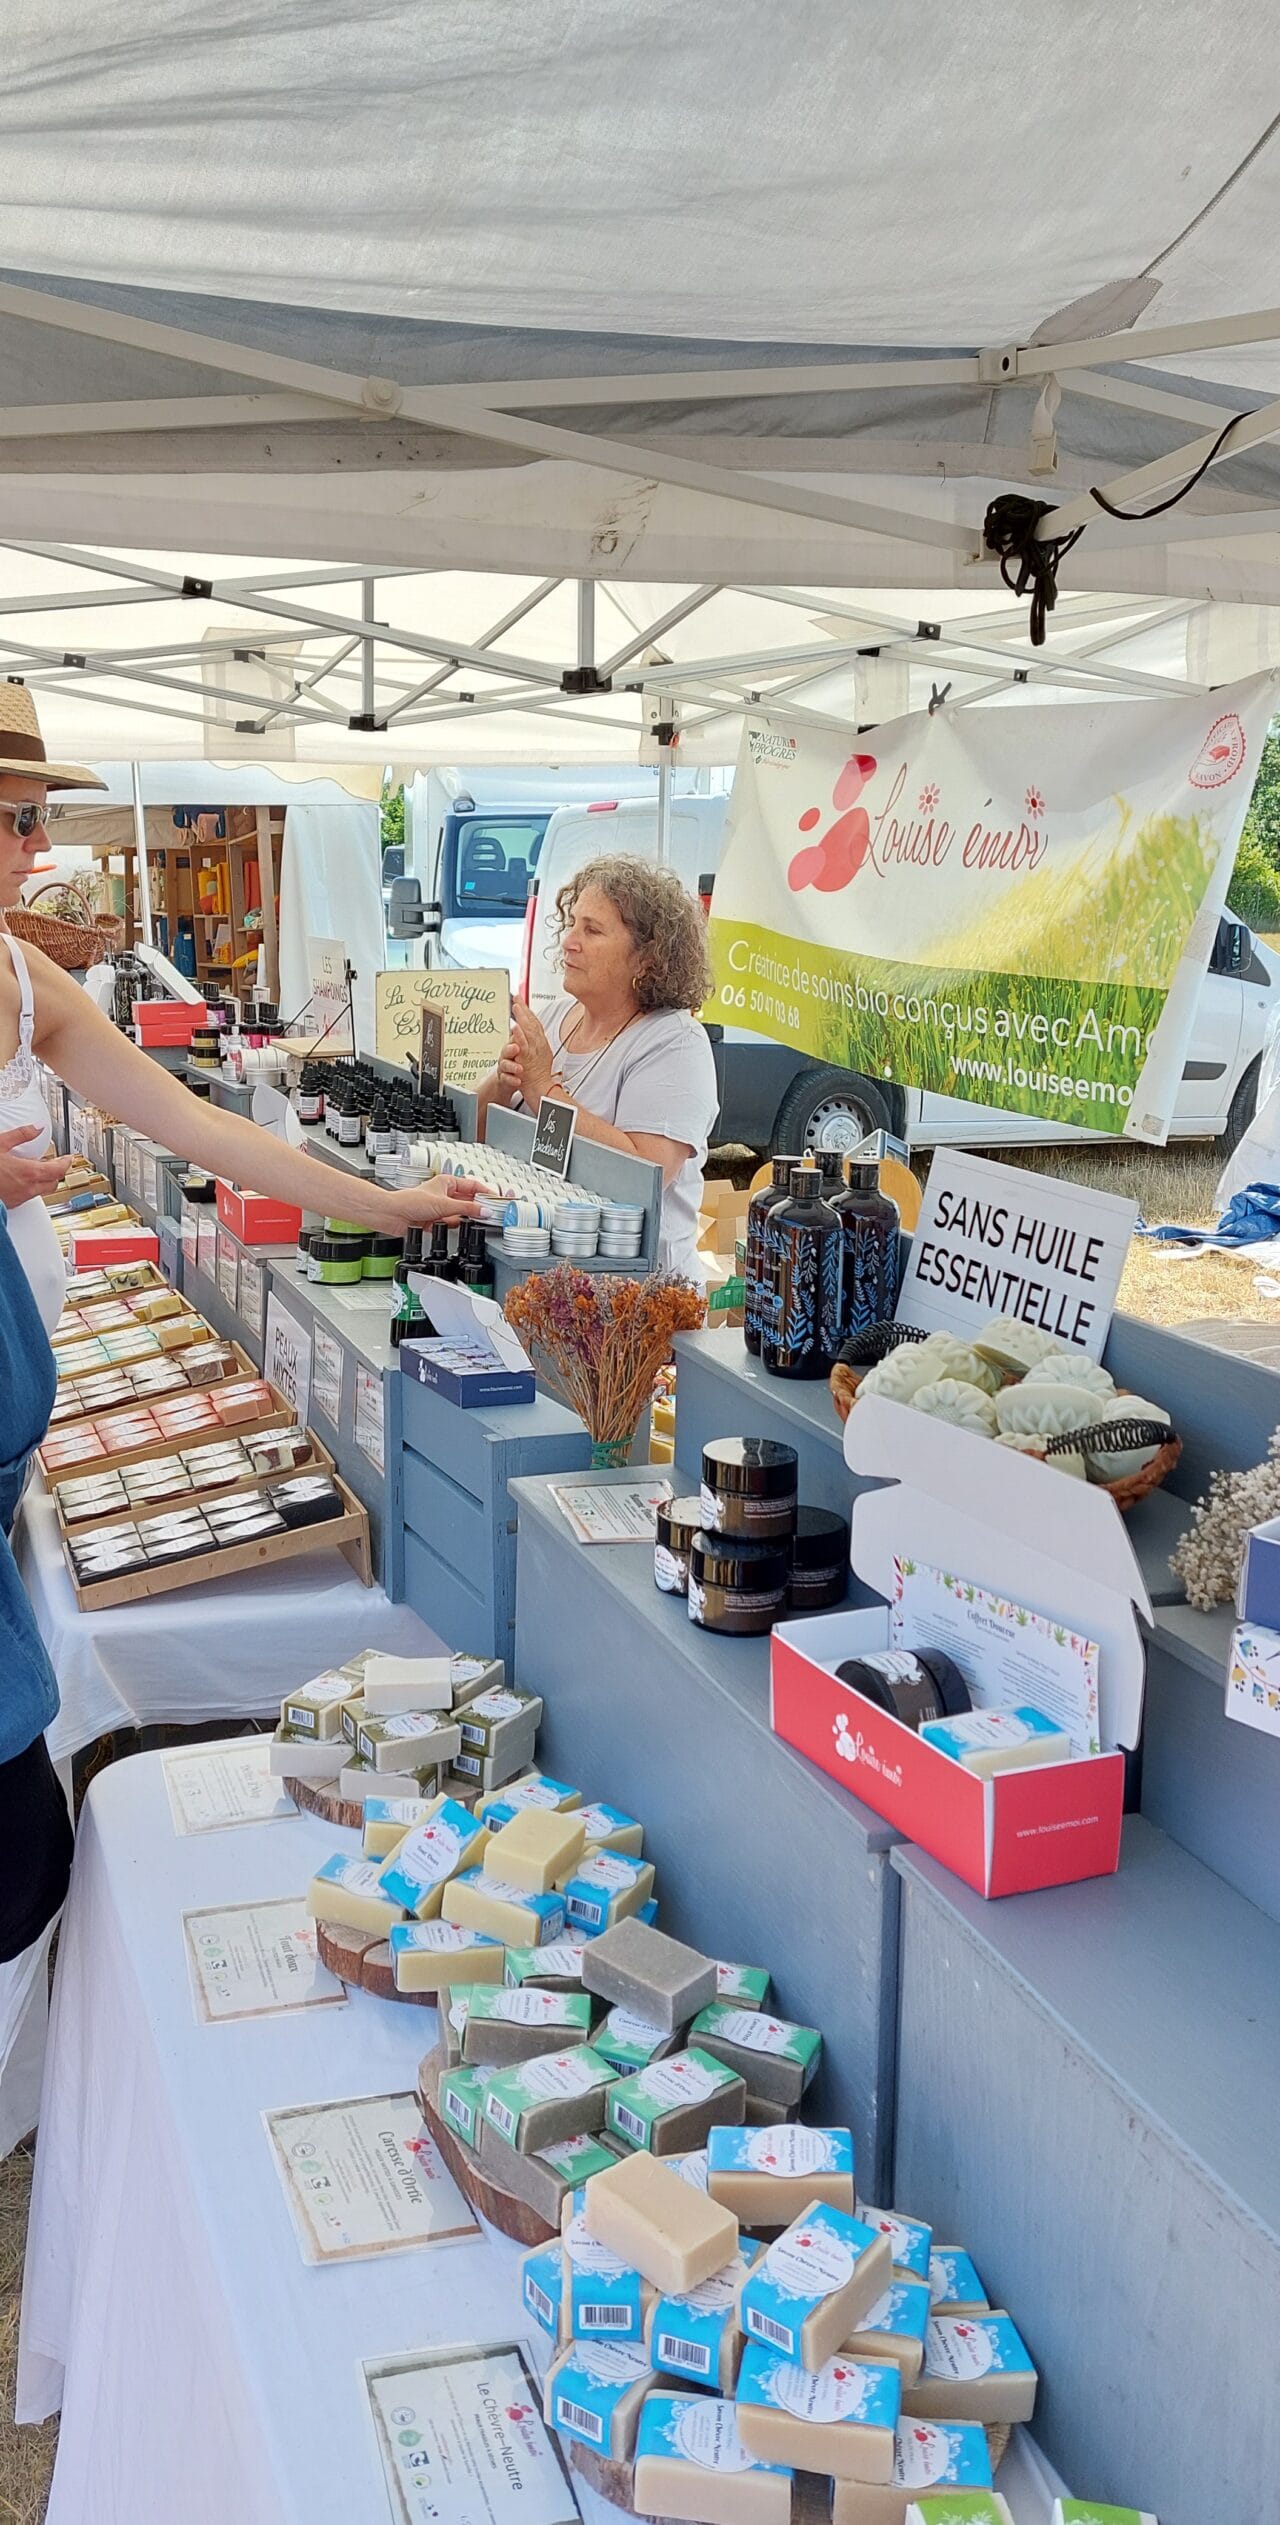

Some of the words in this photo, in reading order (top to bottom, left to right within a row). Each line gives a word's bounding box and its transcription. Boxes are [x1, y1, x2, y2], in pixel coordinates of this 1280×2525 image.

[853, 763, 956, 878] Louise
[385, 985, 405, 1009] La
[414, 978, 496, 1010] Garrigue
[721, 985, 745, 1008] 06
[750, 989, 763, 1013] 50
[763, 994, 774, 1017] 47
[774, 1001, 786, 1024] 03
[788, 1005, 800, 1029] 68
[729, 940, 790, 989] Créatrice
[792, 957, 810, 994] de
[812, 968, 853, 1007] soins
[854, 974, 888, 1016] bio
[893, 994, 987, 1040] conçus
[994, 1009, 1070, 1047] avec
[933, 1190, 1009, 1249] SANS
[1012, 1214, 1104, 1283] HUILE
[915, 1241, 1096, 1346] ESSENTIELLE
[274, 1326, 299, 1375] PEAUX
[272, 1357, 297, 1405] MIXTES
[1016, 1815, 1099, 1839] www.louiseemoi.com
[378, 2130, 403, 2168] Caresse
[396, 2164, 422, 2204] d'Ortie
[776, 2246, 794, 2261] Savon
[932, 2320, 943, 2337] Savon
[476, 2382, 489, 2397] Le
[715, 2403, 725, 2421] Savon
